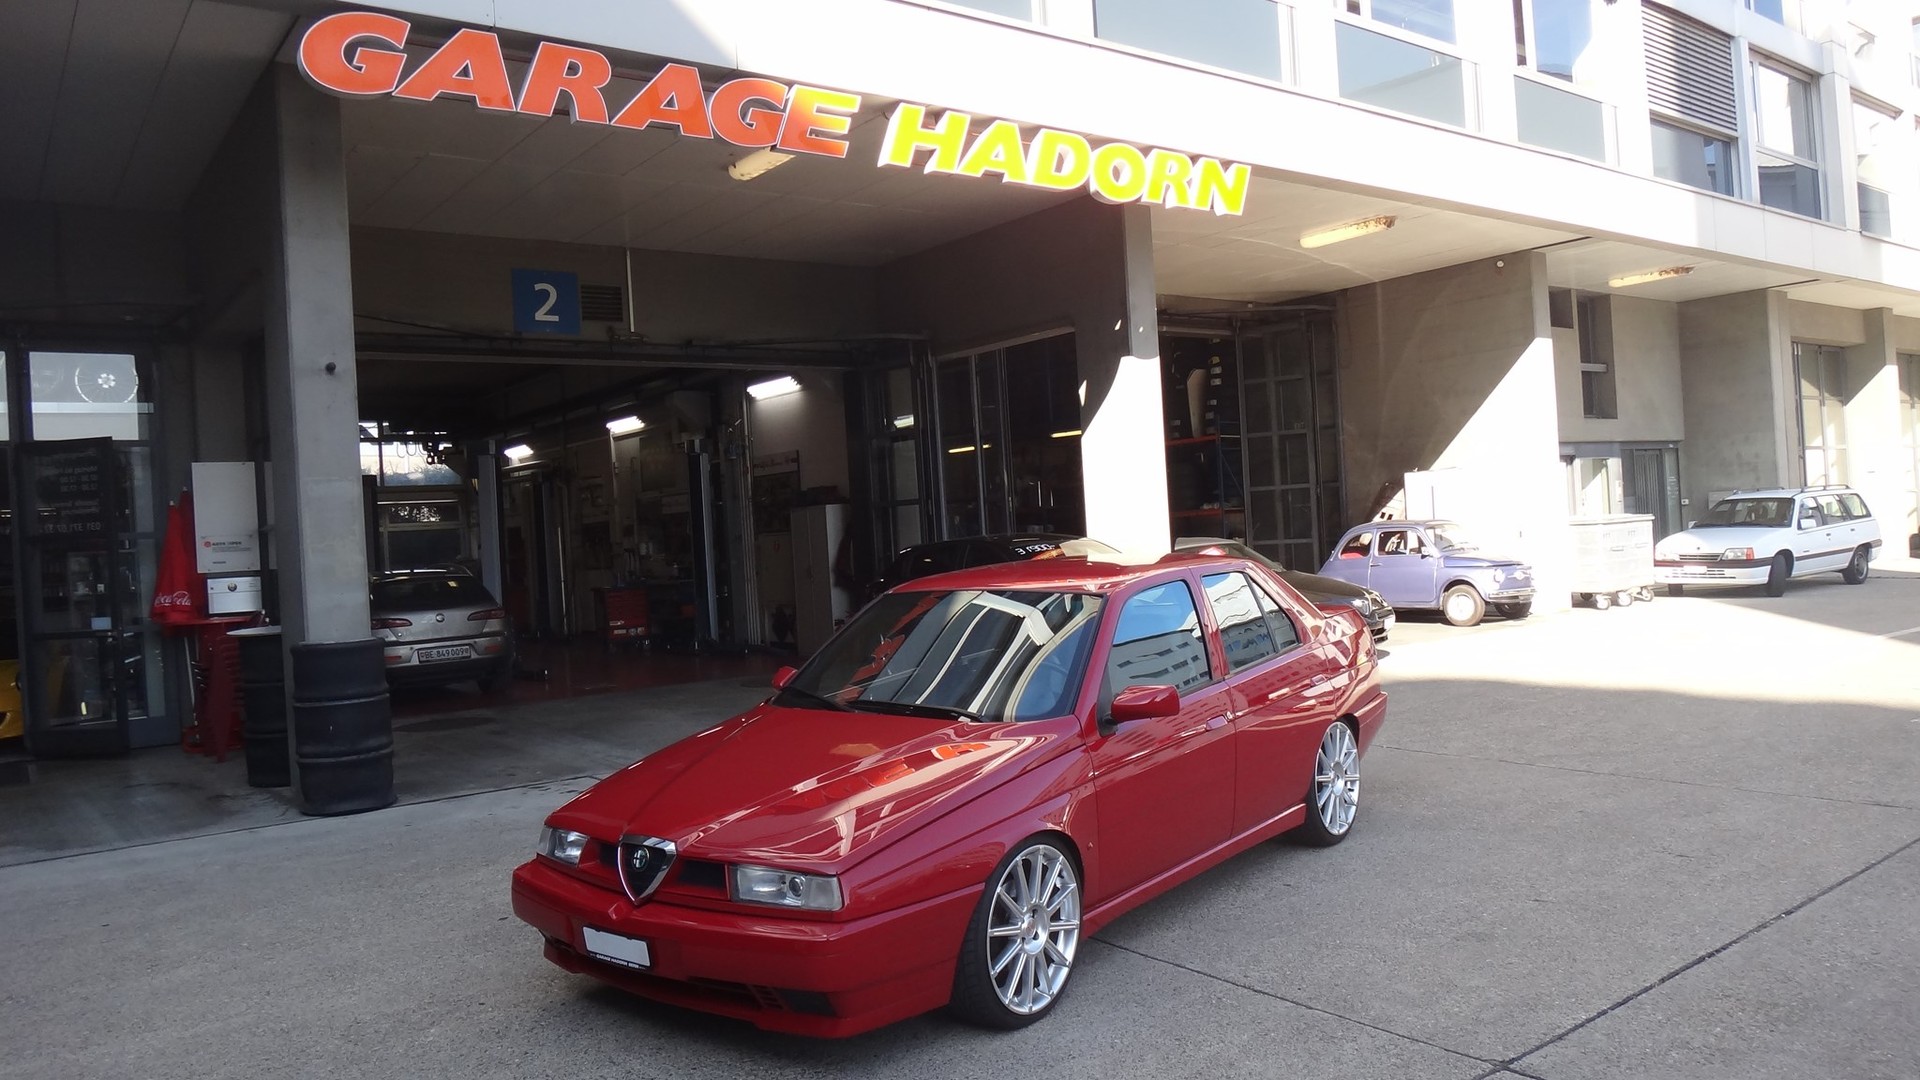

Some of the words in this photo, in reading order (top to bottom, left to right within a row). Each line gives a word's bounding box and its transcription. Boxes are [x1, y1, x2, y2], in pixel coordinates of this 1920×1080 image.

[297, 11, 861, 159] GARAGE
[878, 102, 1253, 217] HADORN
[534, 282, 560, 322] 2
[154, 590, 192, 607] ocaCola
